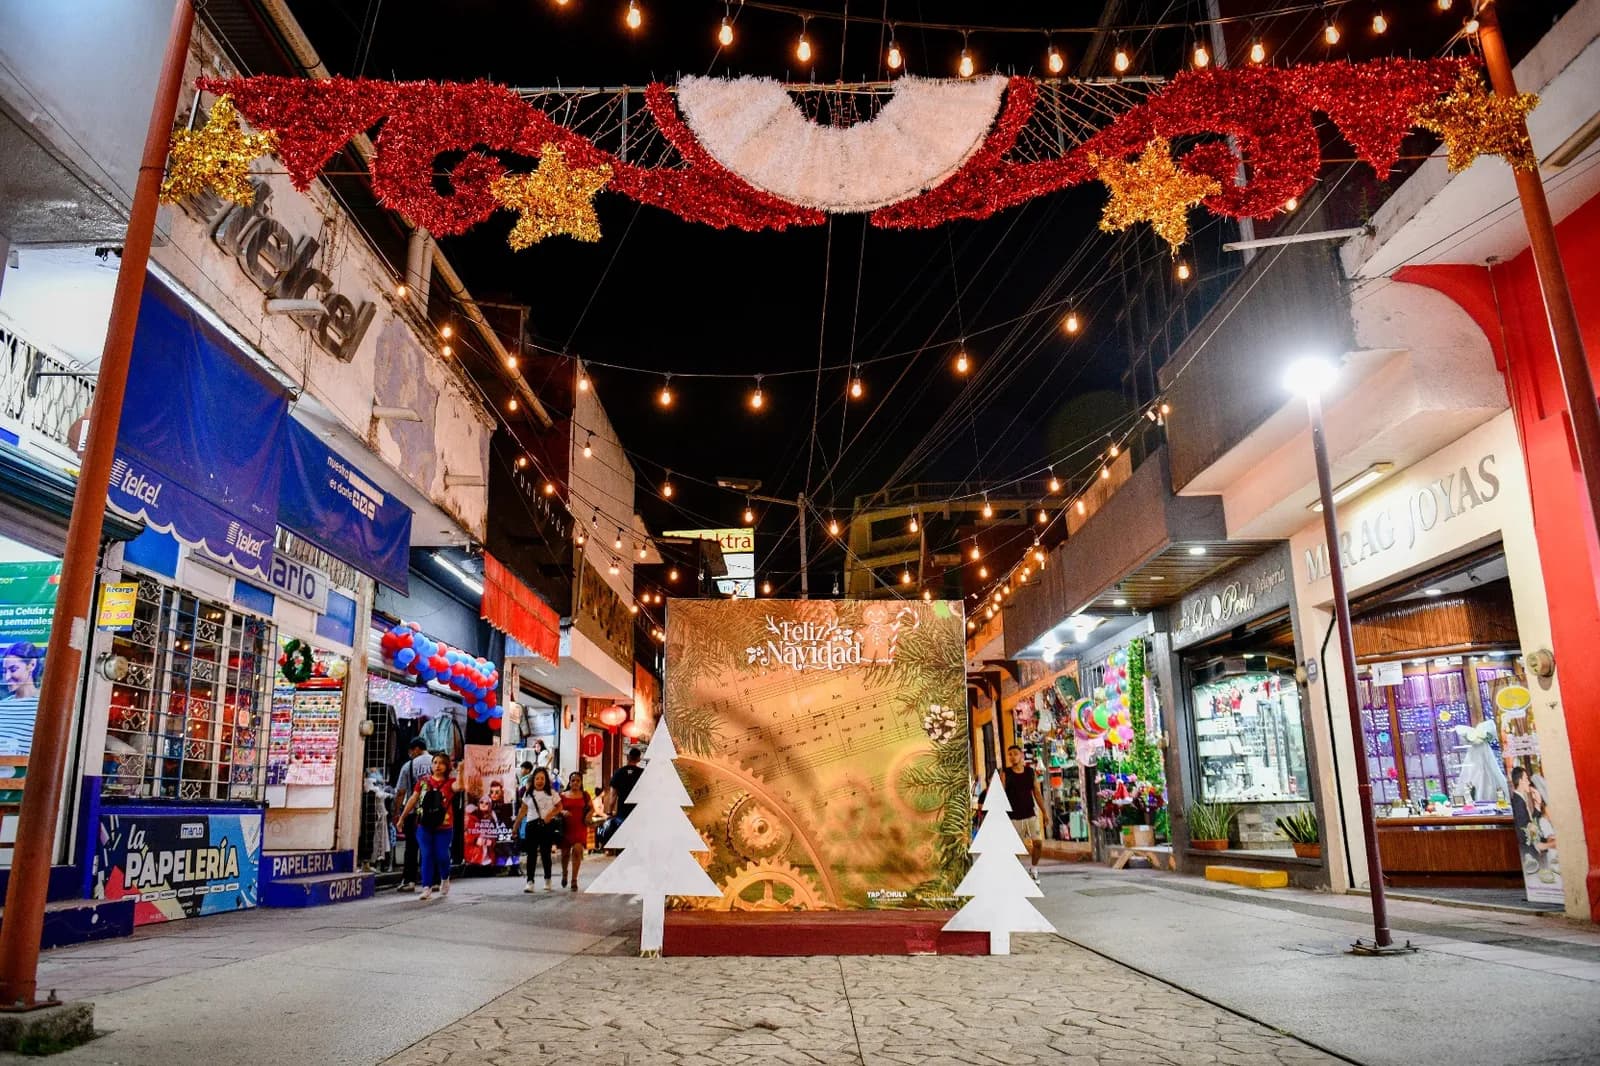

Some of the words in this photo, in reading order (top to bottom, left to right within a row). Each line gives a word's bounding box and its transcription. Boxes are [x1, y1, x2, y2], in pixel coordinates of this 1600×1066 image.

[121, 468, 162, 507] telcel
[1304, 510, 1395, 584] MRAG
[1408, 454, 1500, 550] JOYAS
[236, 528, 265, 559] telcel
[105, 585, 134, 594] Recarga
[267, 557, 316, 600] ario
[15, 606, 47, 616] Celular
[1222, 581, 1256, 621] Perla
[5, 616, 53, 626] semanales
[779, 621, 826, 645] Feliz
[760, 636, 861, 671] Navidad
[127, 823, 145, 850] la
[124, 838, 239, 888] PAPELERÍA
[273, 854, 334, 877] PAPELERIA
[329, 878, 362, 900] COPIAS
